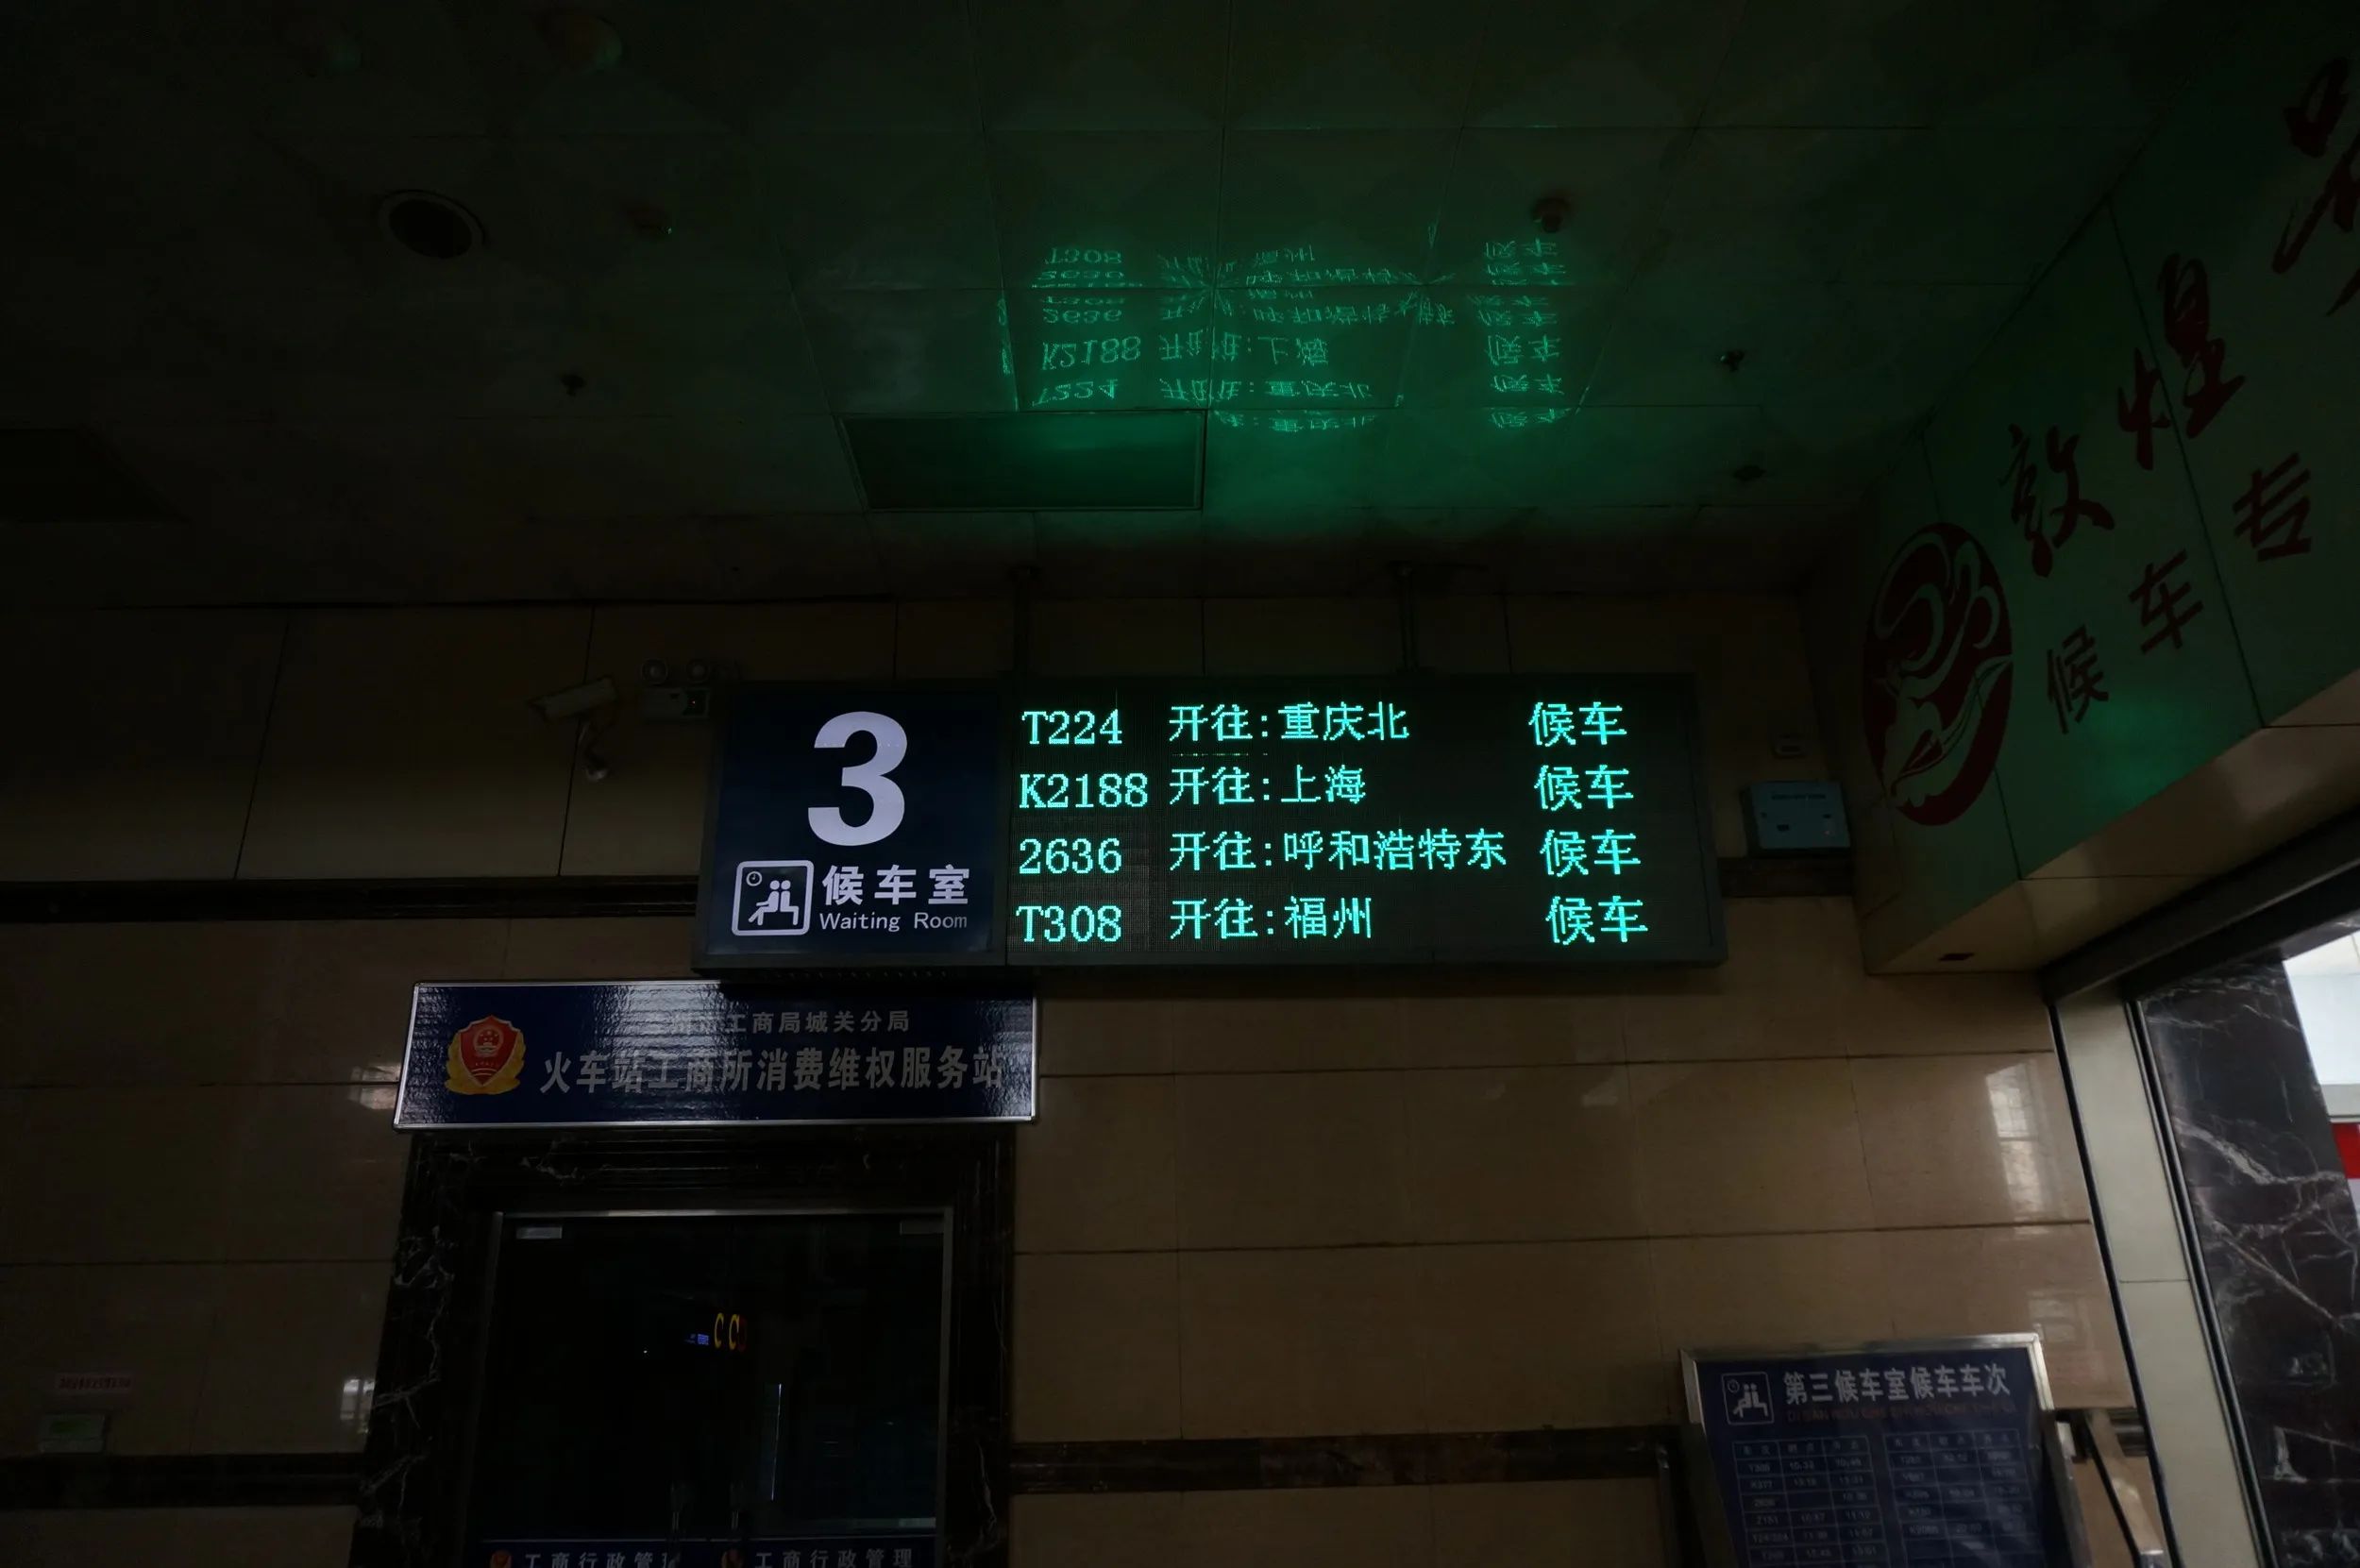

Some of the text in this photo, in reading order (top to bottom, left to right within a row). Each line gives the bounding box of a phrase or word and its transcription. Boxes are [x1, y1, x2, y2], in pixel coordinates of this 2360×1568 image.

[1021, 708, 1123, 747] T224
[1527, 700, 1627, 749] 候车
[808, 711, 908, 848] 3
[1019, 771, 1149, 810] K2188
[1533, 764, 1635, 813] 候车
[1018, 836, 1123, 876] 2636
[1538, 829, 1643, 879] 候车
[821, 864, 971, 906] 候车室
[818, 911, 969, 936] Waiting Room
[1014, 903, 1123, 944] T308
[1544, 895, 1649, 947] 候车
[538, 1044, 1004, 1095] 火车站工商所消费维权服务站
[1781, 1361, 2012, 1406] 第三候车室候车车次
[524, 1551, 675, 1568] 工商行政管
